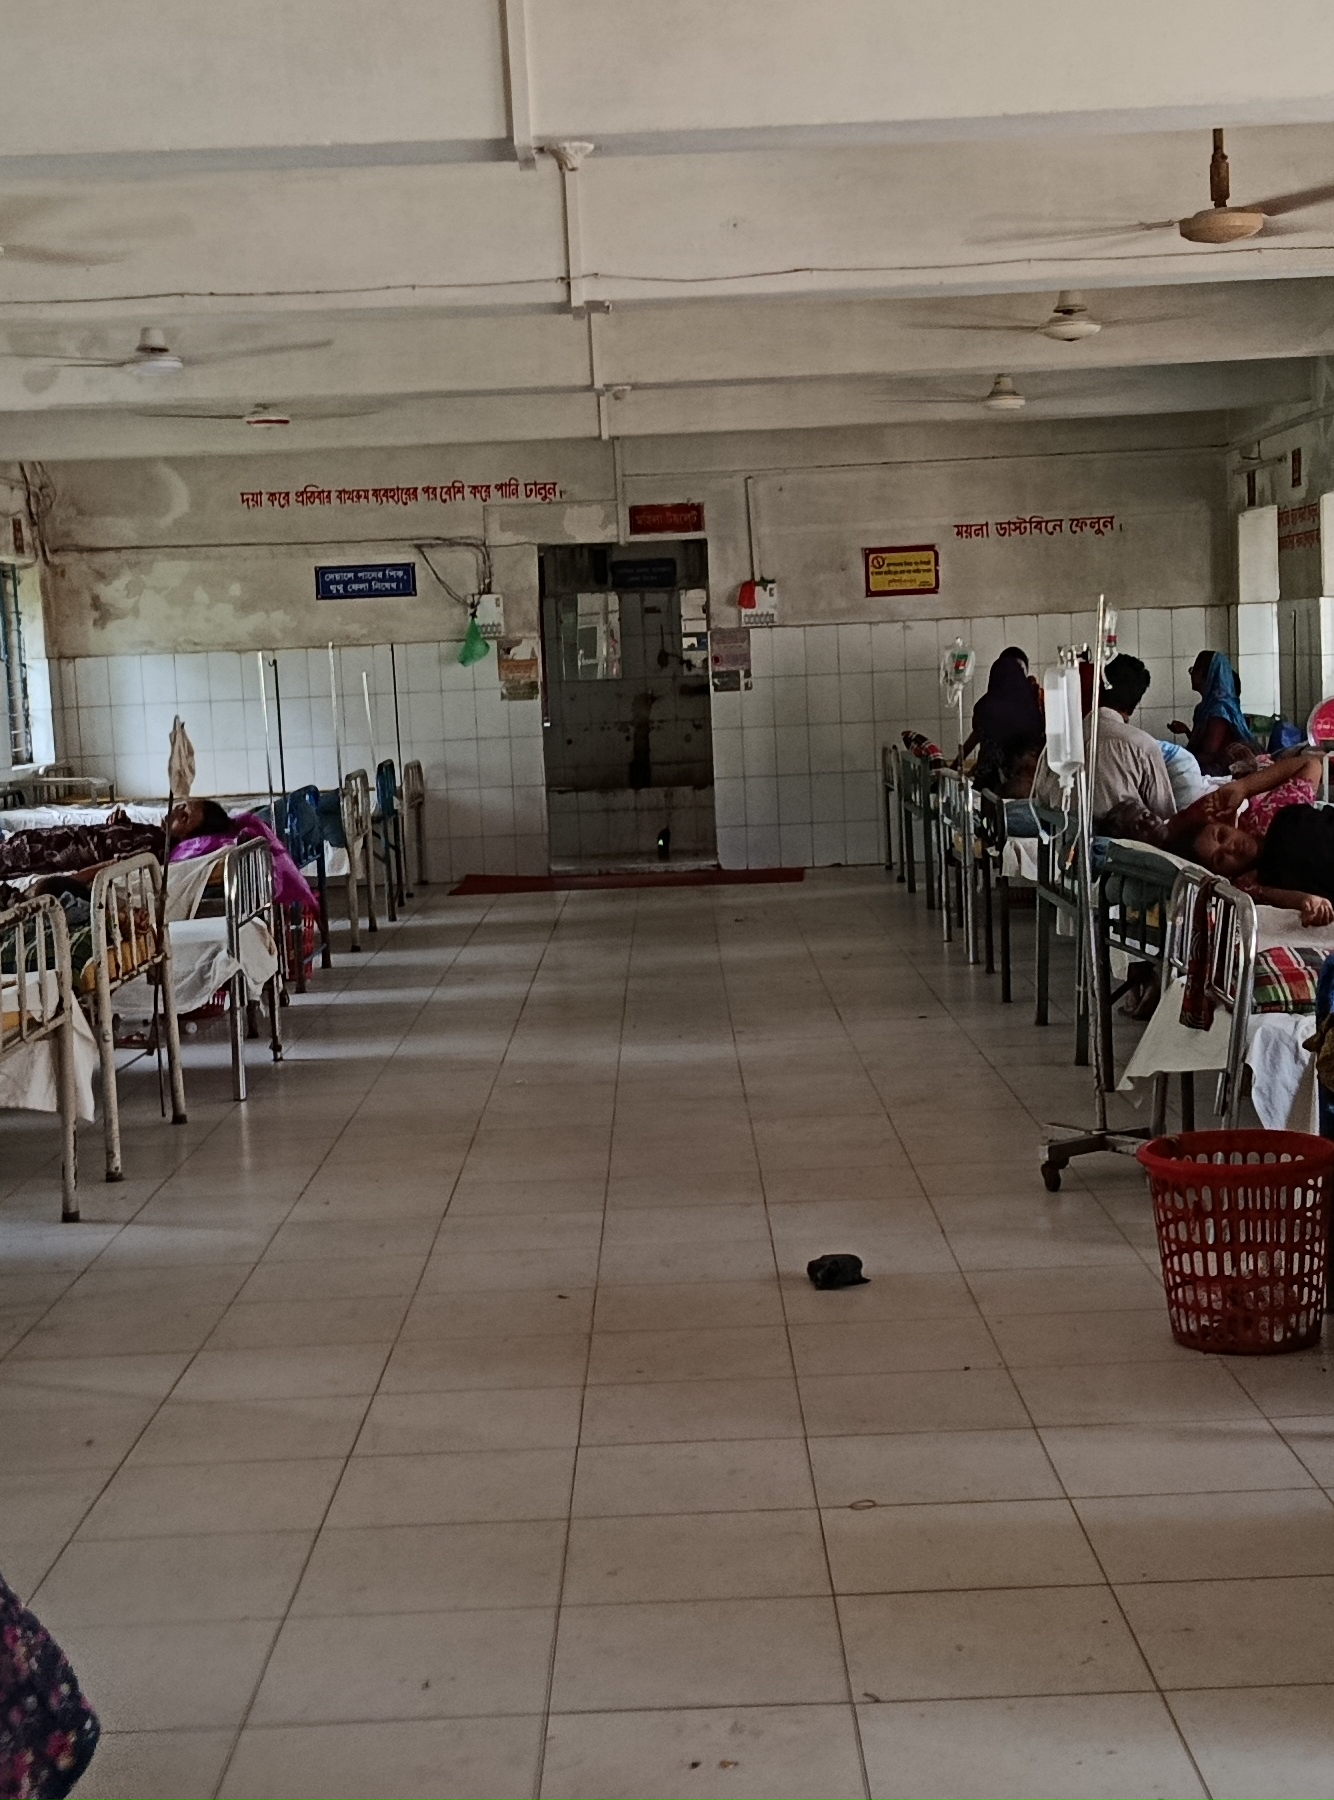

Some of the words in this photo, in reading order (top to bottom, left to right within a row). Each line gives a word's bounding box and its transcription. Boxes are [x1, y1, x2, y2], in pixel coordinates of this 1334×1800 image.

[240, 490, 263, 509] দয়া
[266, 491, 290, 508] করে
[295, 484, 333, 507] প্রতিবার
[335, 488, 370, 505] বাথরুম
[422, 485, 438, 502] পর
[439, 480, 465, 504] বেশি
[467, 484, 492, 503] করে
[494, 477, 519, 500] পানি
[995, 515, 1064, 538] ডাস্টবিনে
